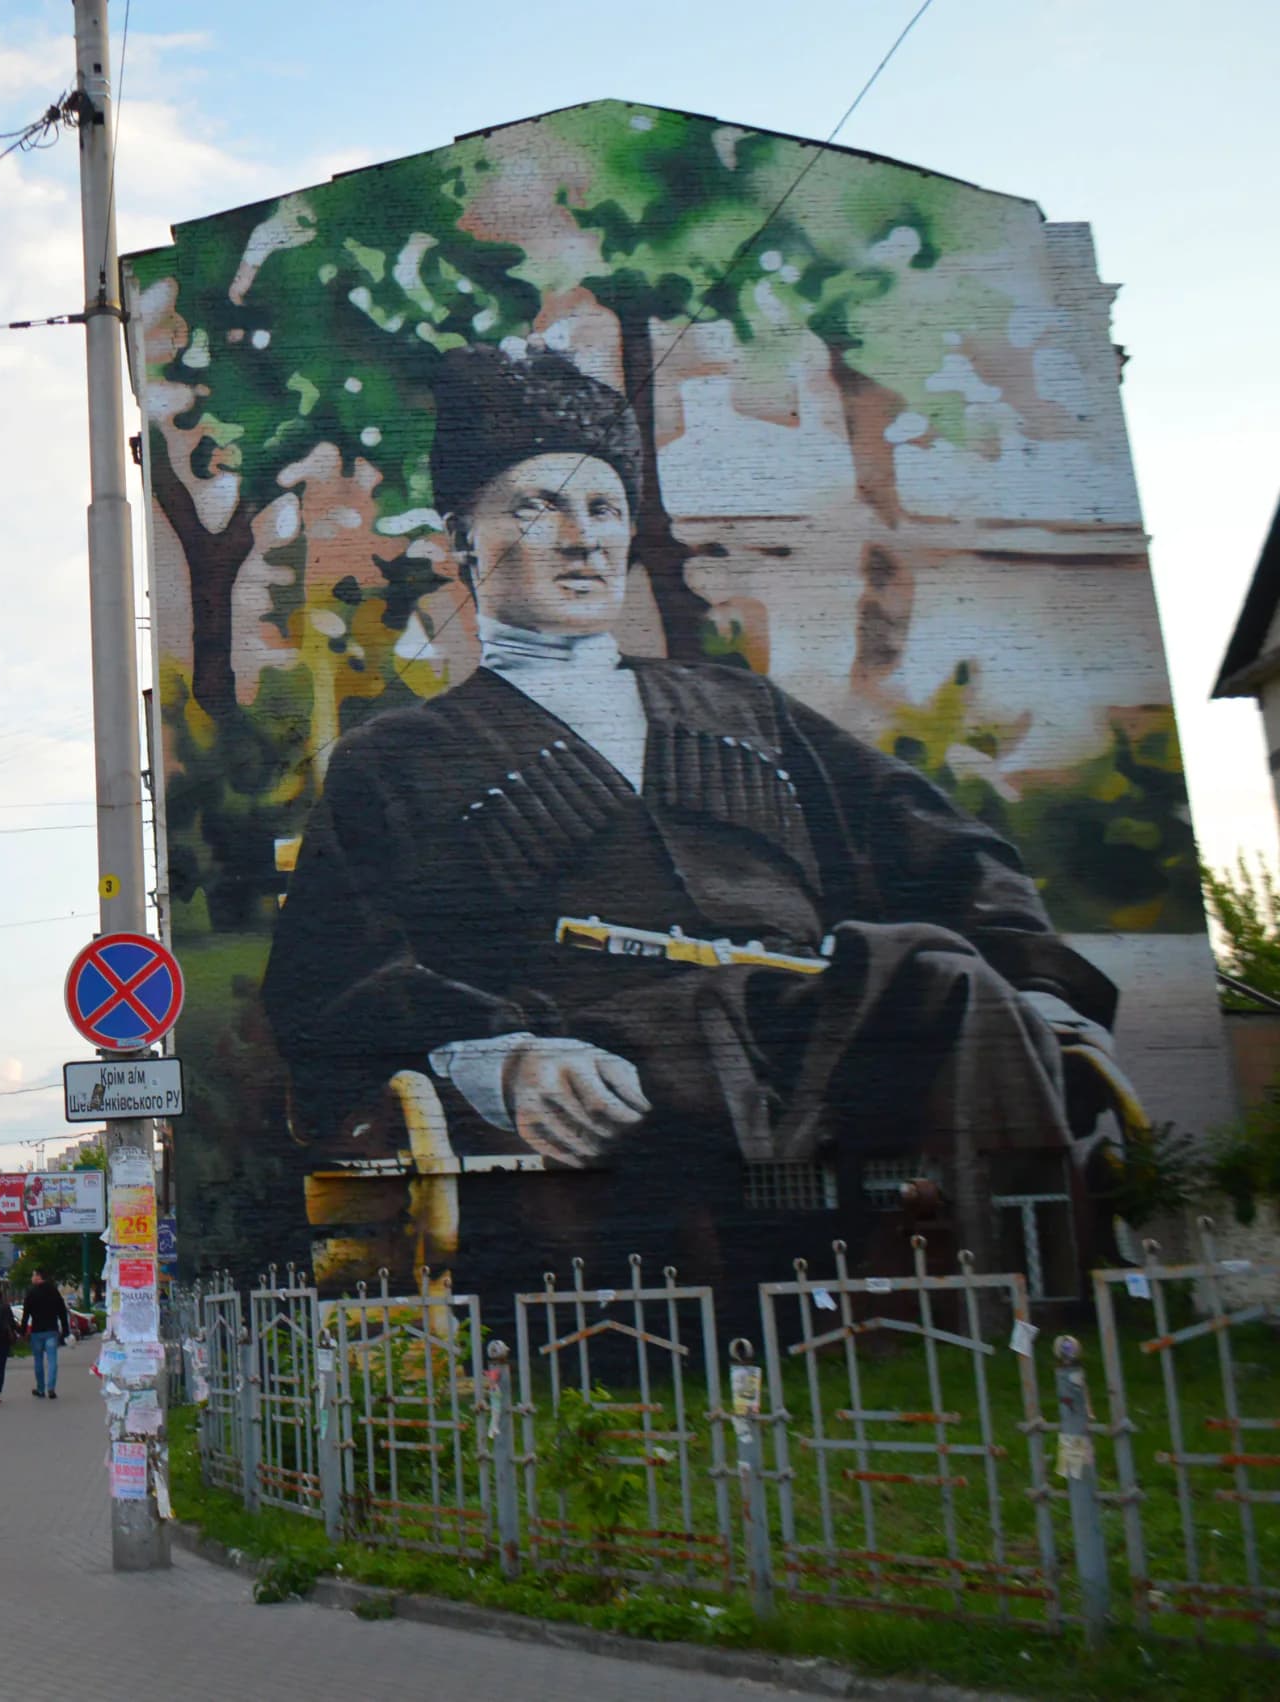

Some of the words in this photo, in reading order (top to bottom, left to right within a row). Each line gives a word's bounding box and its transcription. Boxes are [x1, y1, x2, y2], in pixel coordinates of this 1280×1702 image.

[105, 880, 113, 893] 3
[100, 1067, 124, 1089] Крім
[128, 1066, 145, 1084] а/м
[69, 1092, 163, 1113] Шевенківського
[166, 1089, 181, 1109] РУ
[123, 1216, 148, 1234] 26
